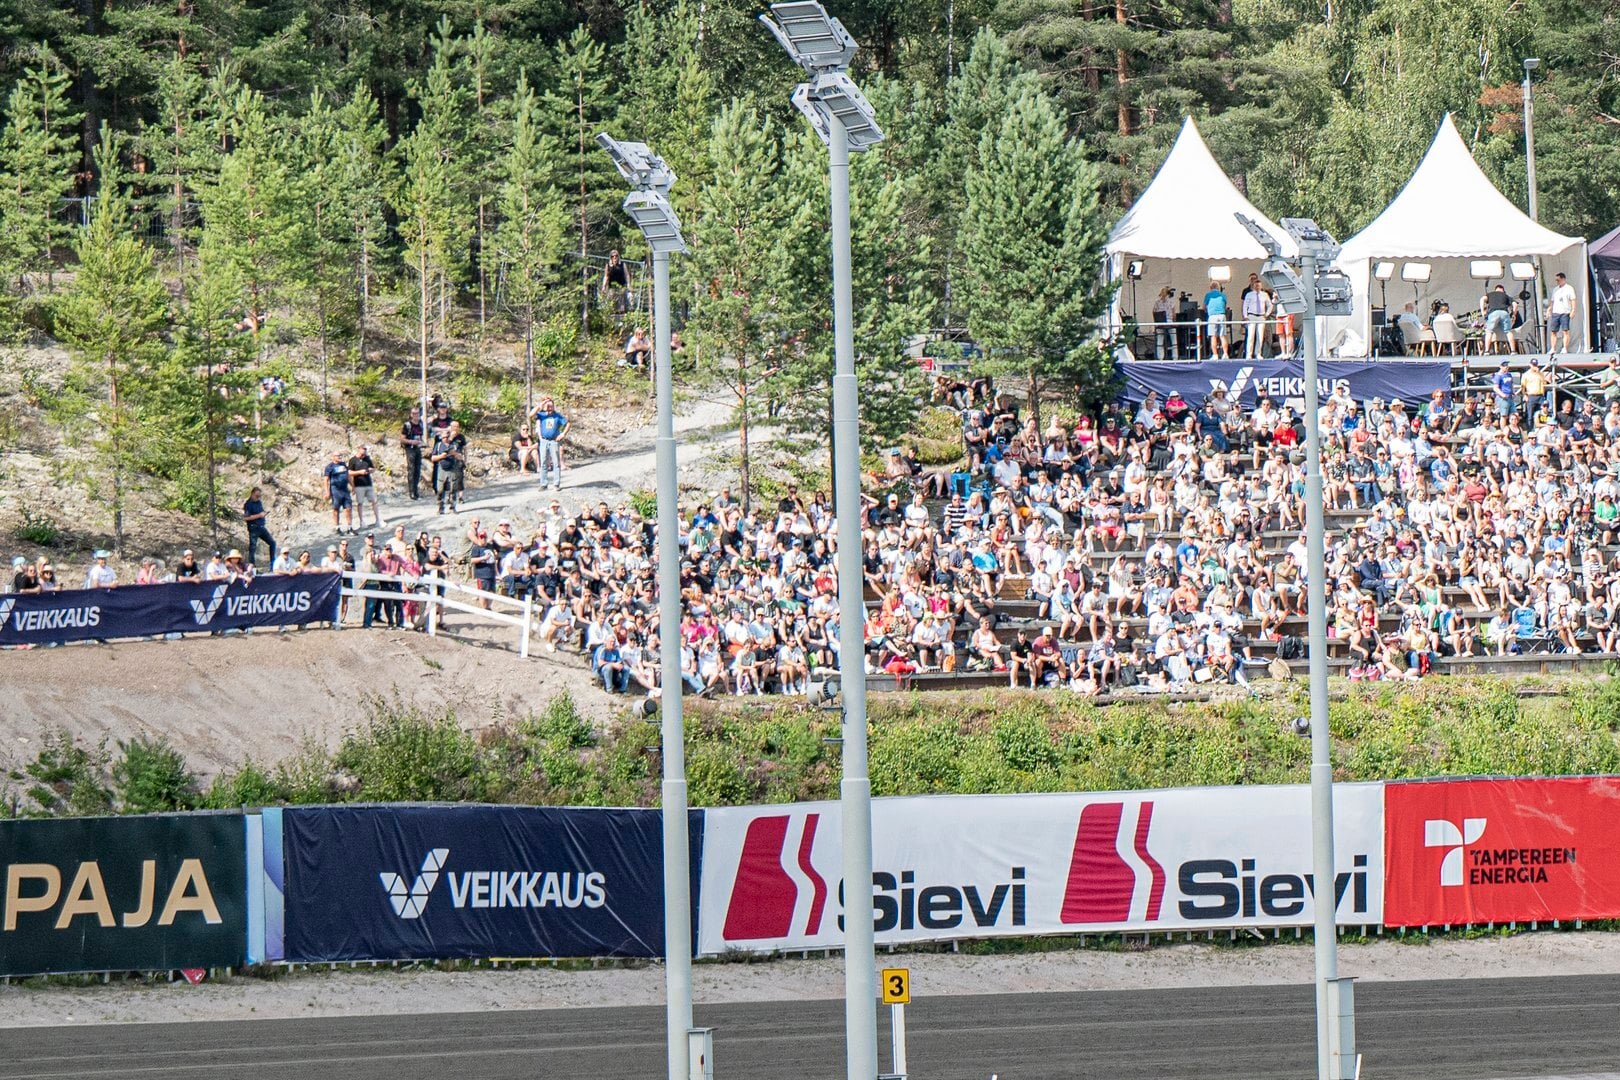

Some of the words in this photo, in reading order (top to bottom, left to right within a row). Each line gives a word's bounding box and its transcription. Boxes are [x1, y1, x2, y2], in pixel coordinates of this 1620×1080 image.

[1252, 377, 1351, 396] VEIKKAUS
[227, 591, 311, 616] VEIKKAUS
[14, 606, 100, 632] VEIKKAUS
[1470, 847, 1577, 866] TAMPEREEN
[1178, 854, 1368, 920] Sievi
[1470, 864, 1549, 885] ENERGIA
[4, 858, 222, 931] PAJA
[448, 871, 606, 909] VEIKKAUS
[837, 866, 1026, 933] Sievi
[889, 976, 904, 996] 3
